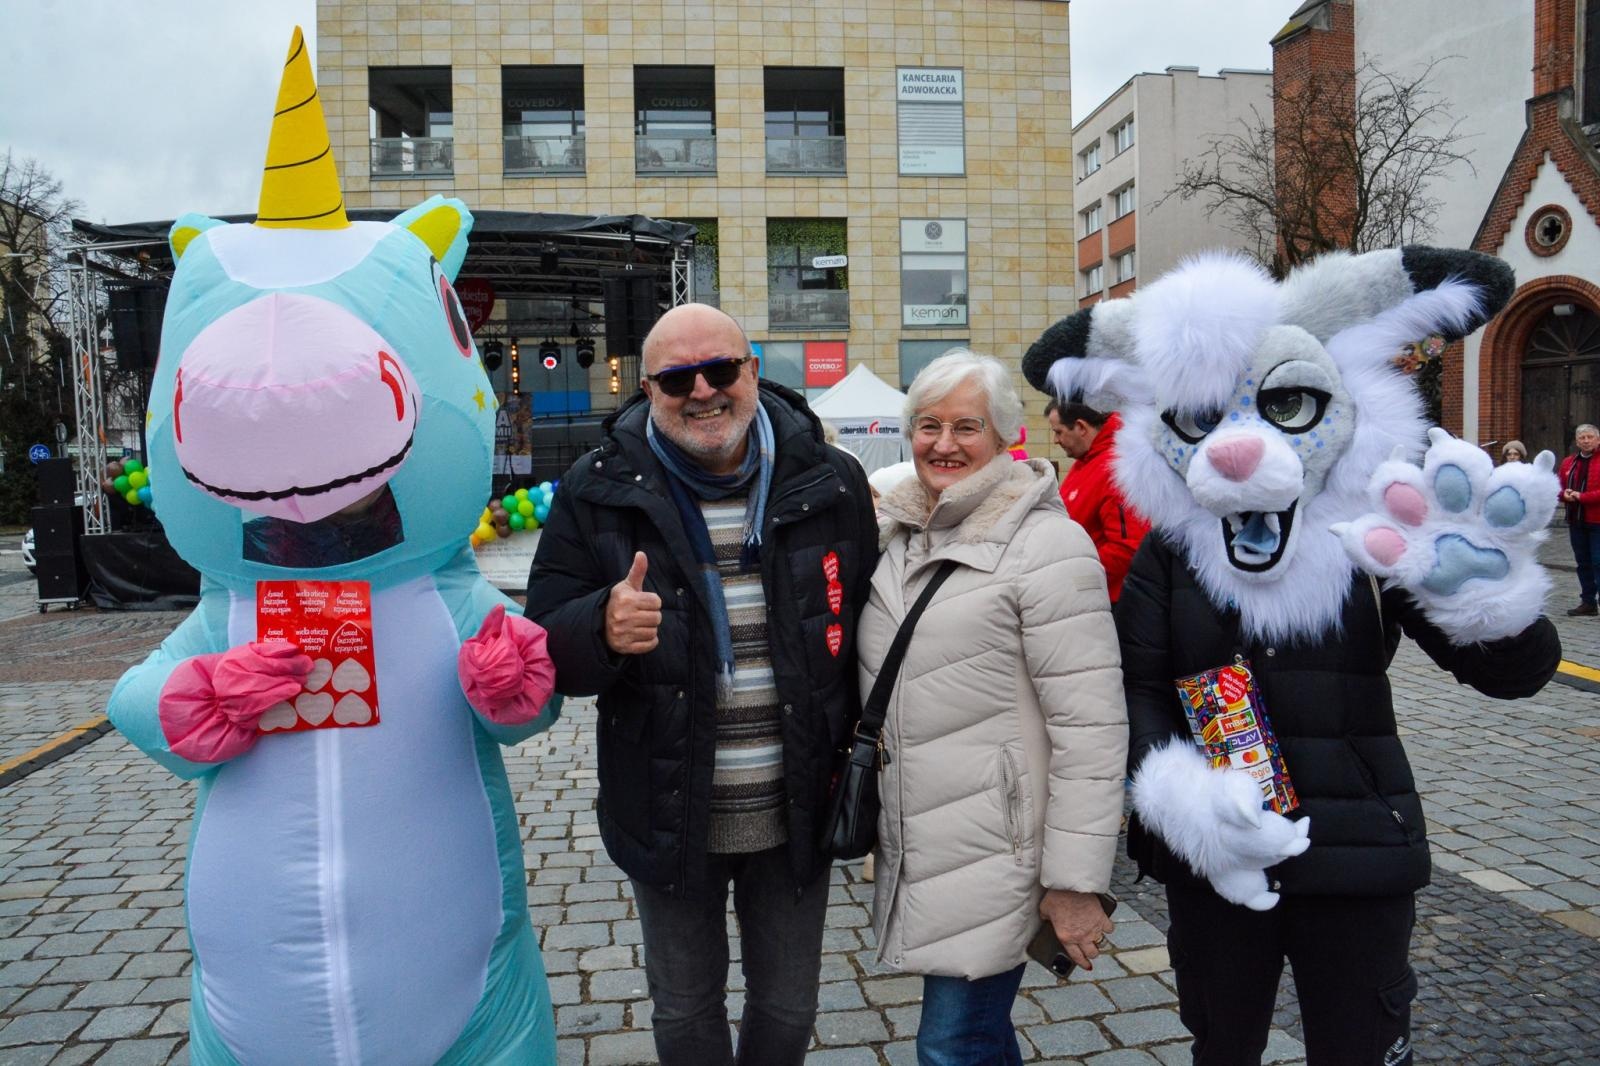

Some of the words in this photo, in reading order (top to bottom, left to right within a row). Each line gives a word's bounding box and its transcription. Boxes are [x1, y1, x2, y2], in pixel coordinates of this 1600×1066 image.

[902, 73, 956, 83] KANCELARIA
[902, 85, 957, 95] ADWOKACKA
[507, 98, 555, 108] COVEBO
[651, 97, 699, 107] COVEBO
[839, 425, 868, 434] ciborskie
[1225, 715, 1251, 729] mBank
[1231, 732, 1257, 745] PLAY
[1251, 766, 1270, 779] egro
